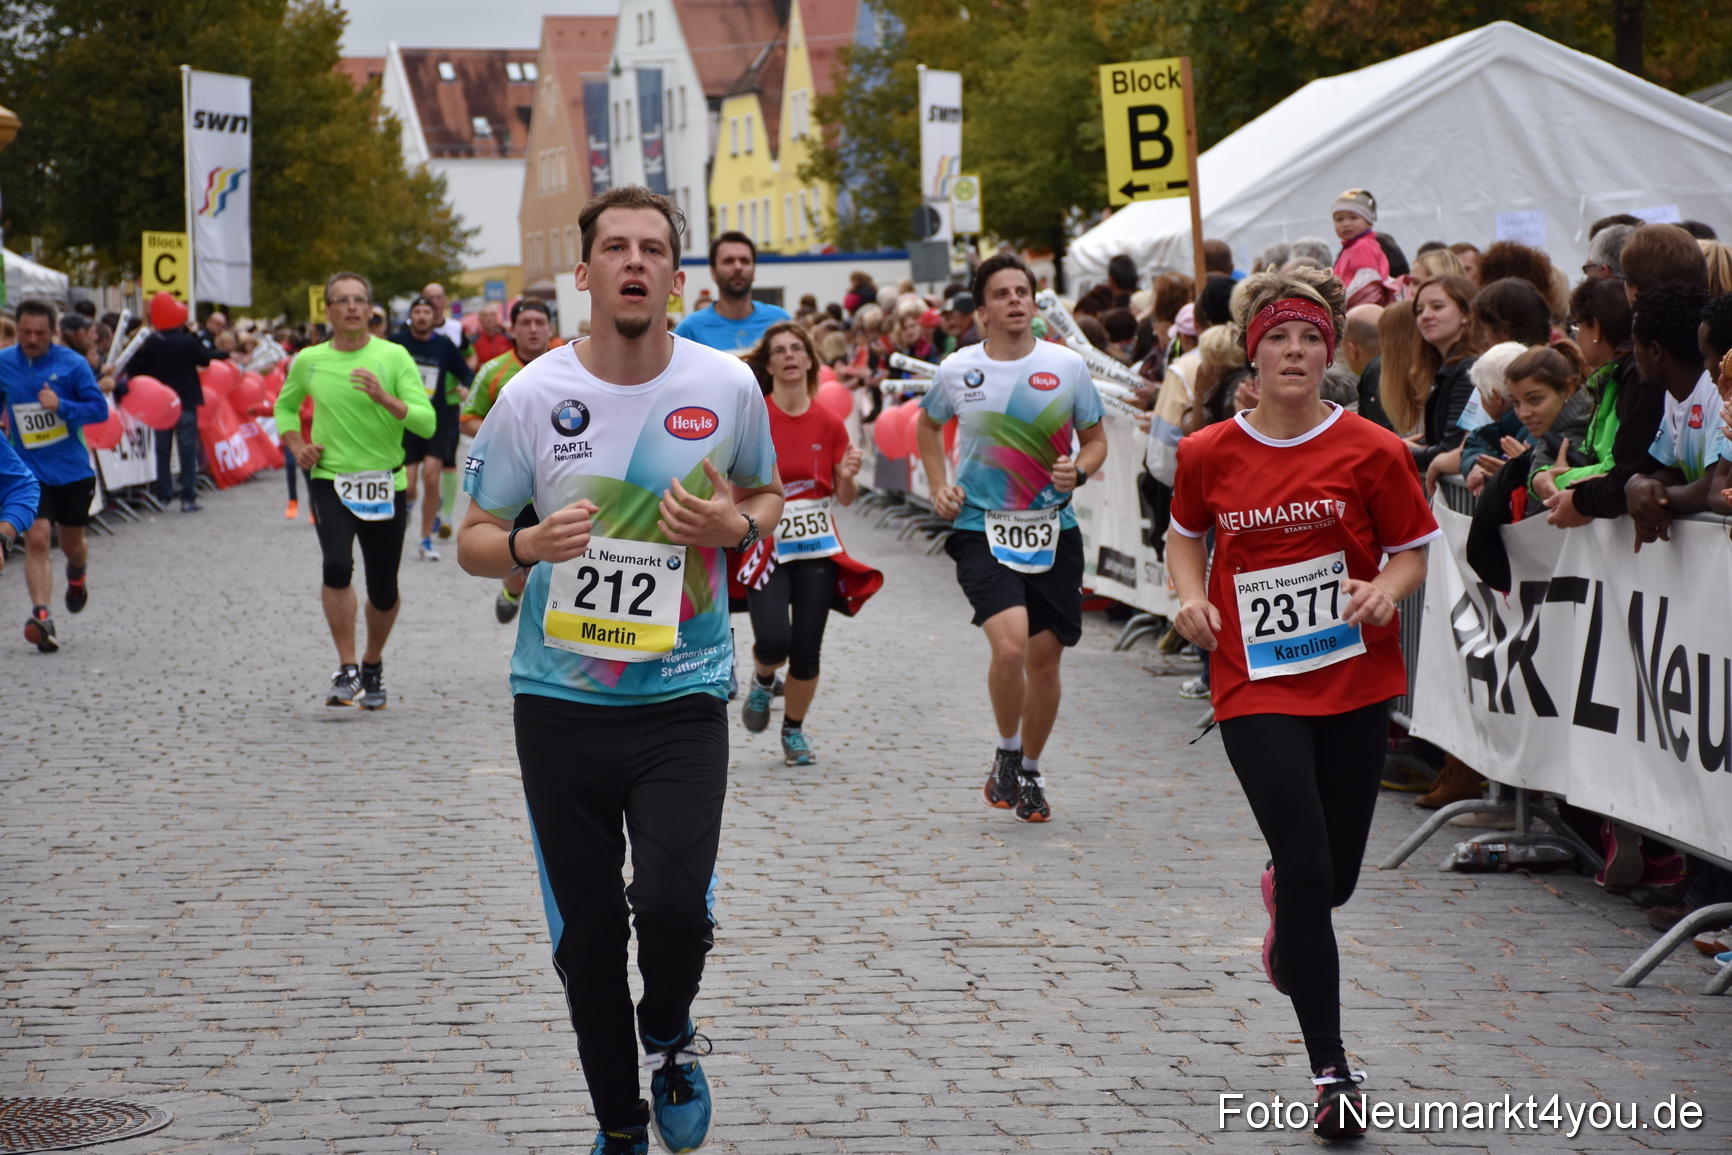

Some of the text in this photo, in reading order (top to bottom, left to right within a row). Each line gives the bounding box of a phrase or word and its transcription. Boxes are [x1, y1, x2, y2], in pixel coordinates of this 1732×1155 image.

[1112, 65, 1182, 94] Block
[194, 109, 249, 134] swn
[1127, 104, 1174, 171] B
[148, 234, 184, 250] Block
[154, 253, 177, 285] C
[553, 401, 585, 414] BMW
[24, 412, 56, 431] 300
[672, 415, 713, 432] Hervis
[553, 440, 593, 454] PARTL
[554, 450, 593, 462] Neumarkt
[341, 481, 389, 501] 2105
[779, 511, 829, 540] 2553
[987, 512, 1047, 523] PARTL Neumarkt
[1218, 499, 1333, 531] NEUMARKT
[1284, 520, 1336, 534] STARKE STADT
[797, 541, 822, 552] Birgit
[993, 523, 1053, 548] 3063
[599, 550, 662, 567] Neumarkt
[573, 565, 656, 617] 212
[1238, 567, 1329, 594] PARTL Neumarkt
[1251, 580, 1340, 638] 2377
[581, 622, 636, 646] Martin
[1274, 634, 1337, 661] Karoline
